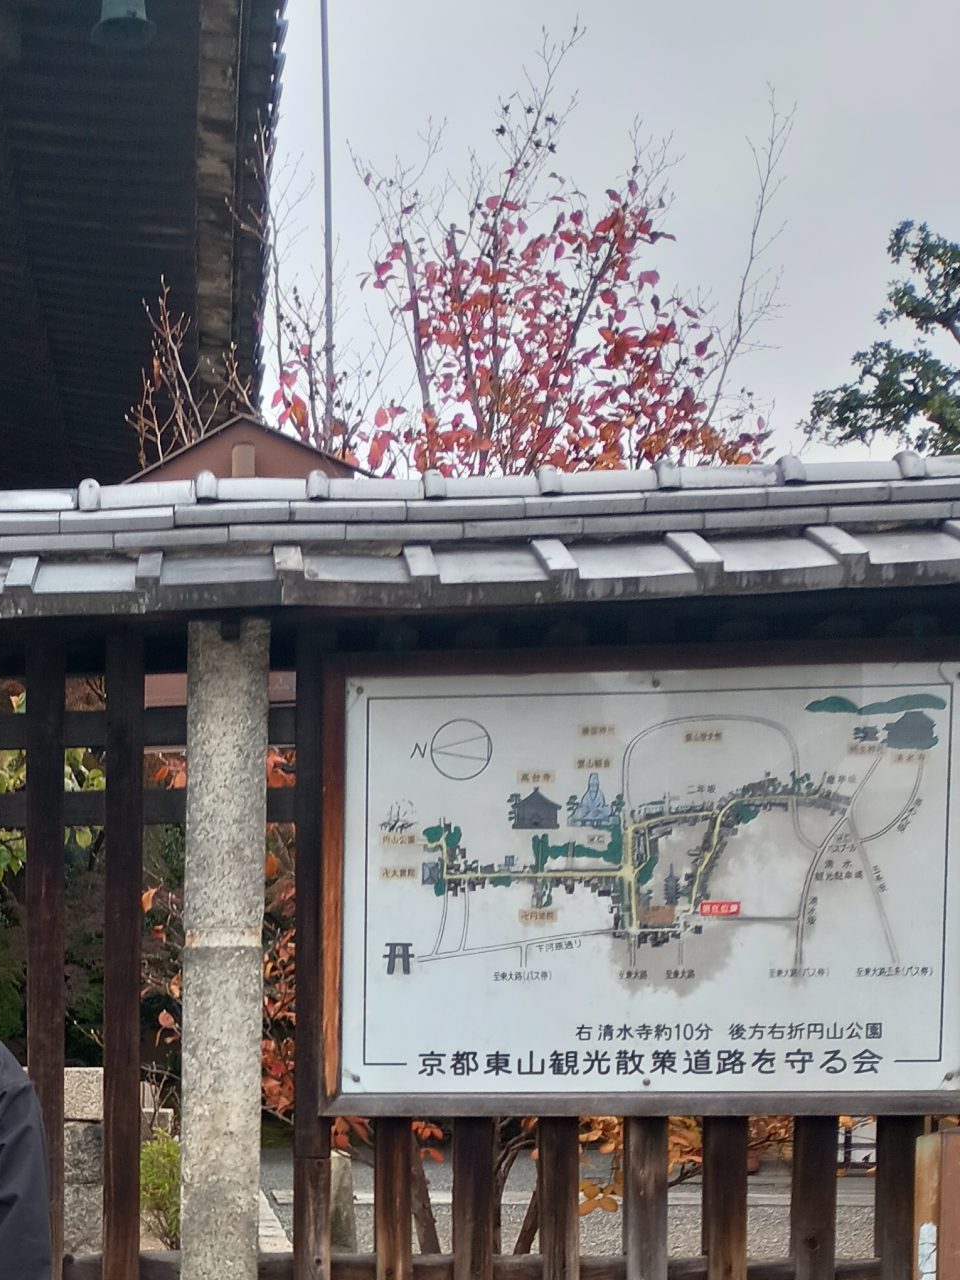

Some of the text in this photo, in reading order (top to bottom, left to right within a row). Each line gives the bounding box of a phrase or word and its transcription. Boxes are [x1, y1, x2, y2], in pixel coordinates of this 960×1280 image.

[410, 742, 428, 759] N
[536, 939, 582, 952] 下河原通り
[729, 1022, 884, 1041] 後方右折円山公園
[418, 1048, 884, 1077] 京都東山観光散策道路を守る会
